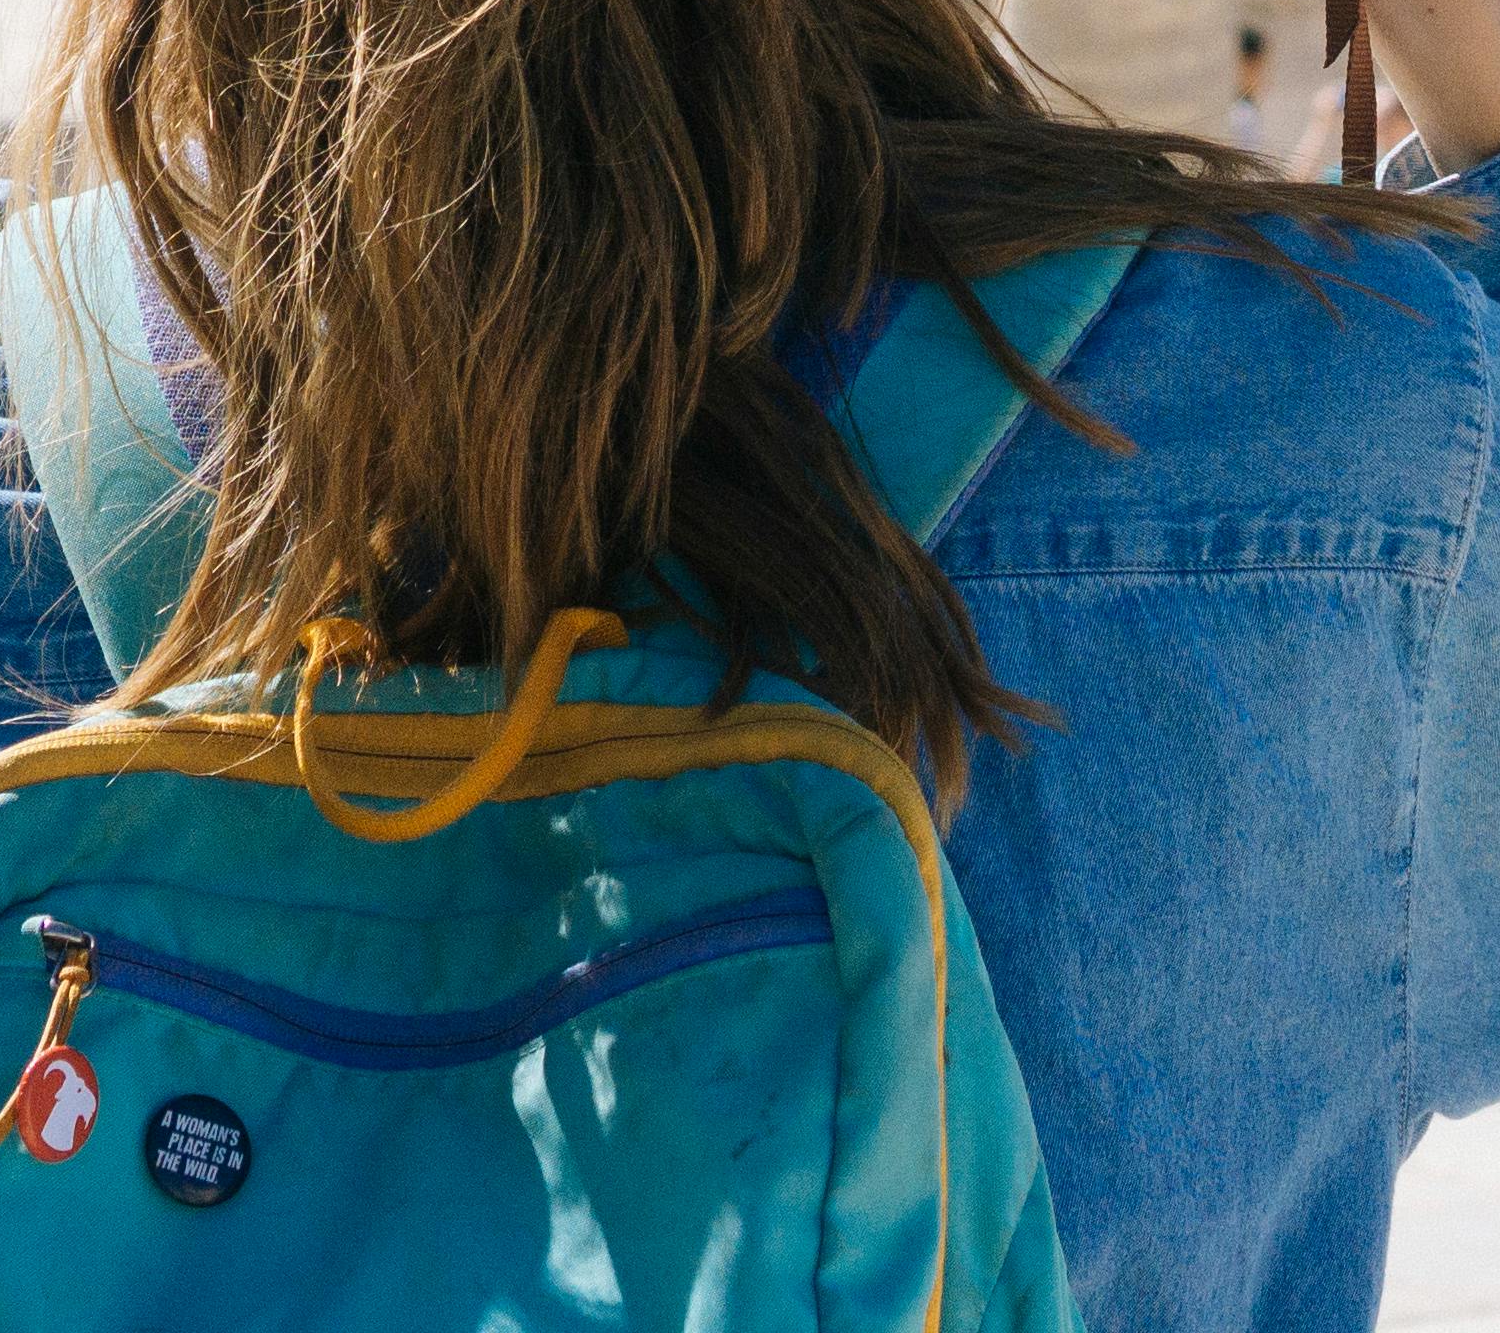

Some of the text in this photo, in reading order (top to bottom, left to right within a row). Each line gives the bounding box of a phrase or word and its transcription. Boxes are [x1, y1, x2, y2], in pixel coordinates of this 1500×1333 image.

[161, 1110, 240, 1146] A WOMAN'S
[156, 1149, 219, 1184] THE WILD.
[168, 1132, 244, 1170] PLACE IS IN
